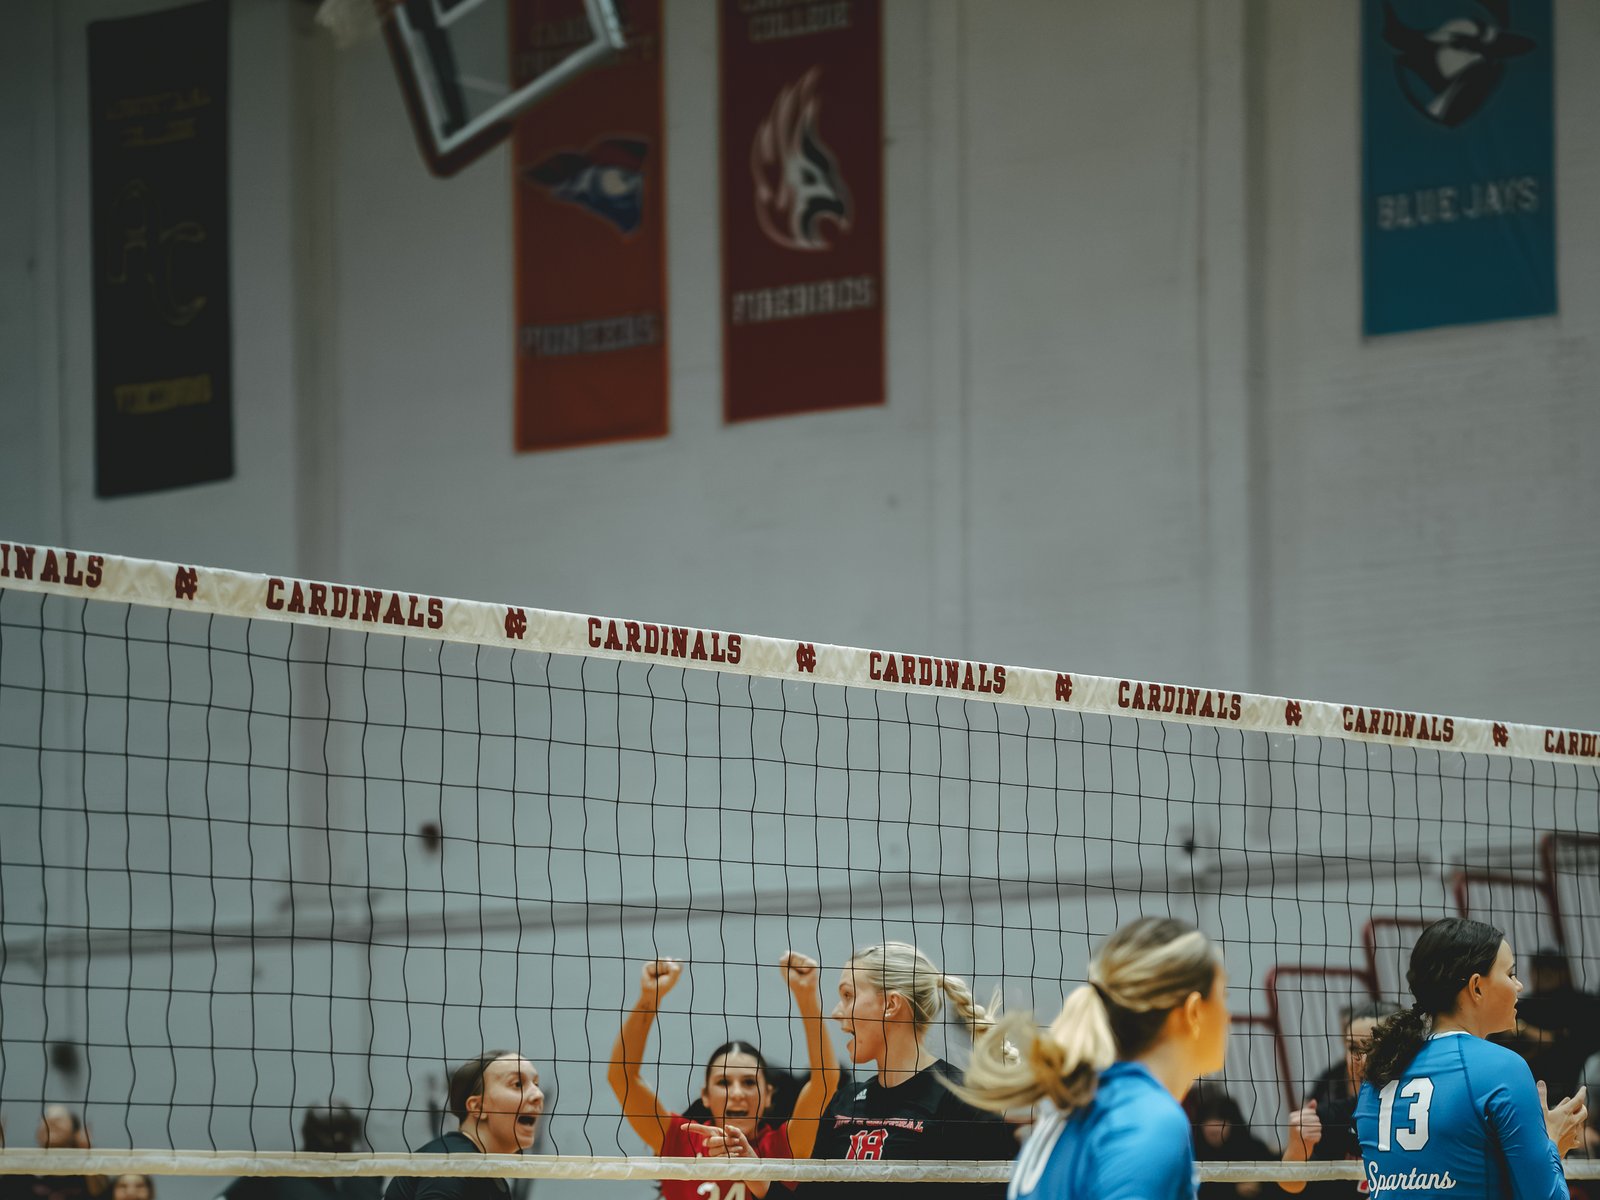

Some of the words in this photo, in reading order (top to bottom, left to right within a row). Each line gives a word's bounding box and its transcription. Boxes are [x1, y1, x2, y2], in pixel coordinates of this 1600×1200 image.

[1376, 186, 1458, 231] BLUE
[1461, 175, 1539, 219] JAYS
[0, 544, 104, 588] INALS
[266, 578, 444, 630] CARDINALS
[587, 617, 742, 665] CARDINALS
[869, 651, 1007, 695] CARDINALS
[1117, 681, 1242, 721] CARDINALS
[1343, 706, 1454, 743] CARDINALS
[1544, 729, 1600, 758] CARDI
[1378, 1077, 1434, 1152] 13
[845, 1128, 889, 1160] 18
[1368, 1161, 1457, 1199] Spartans
